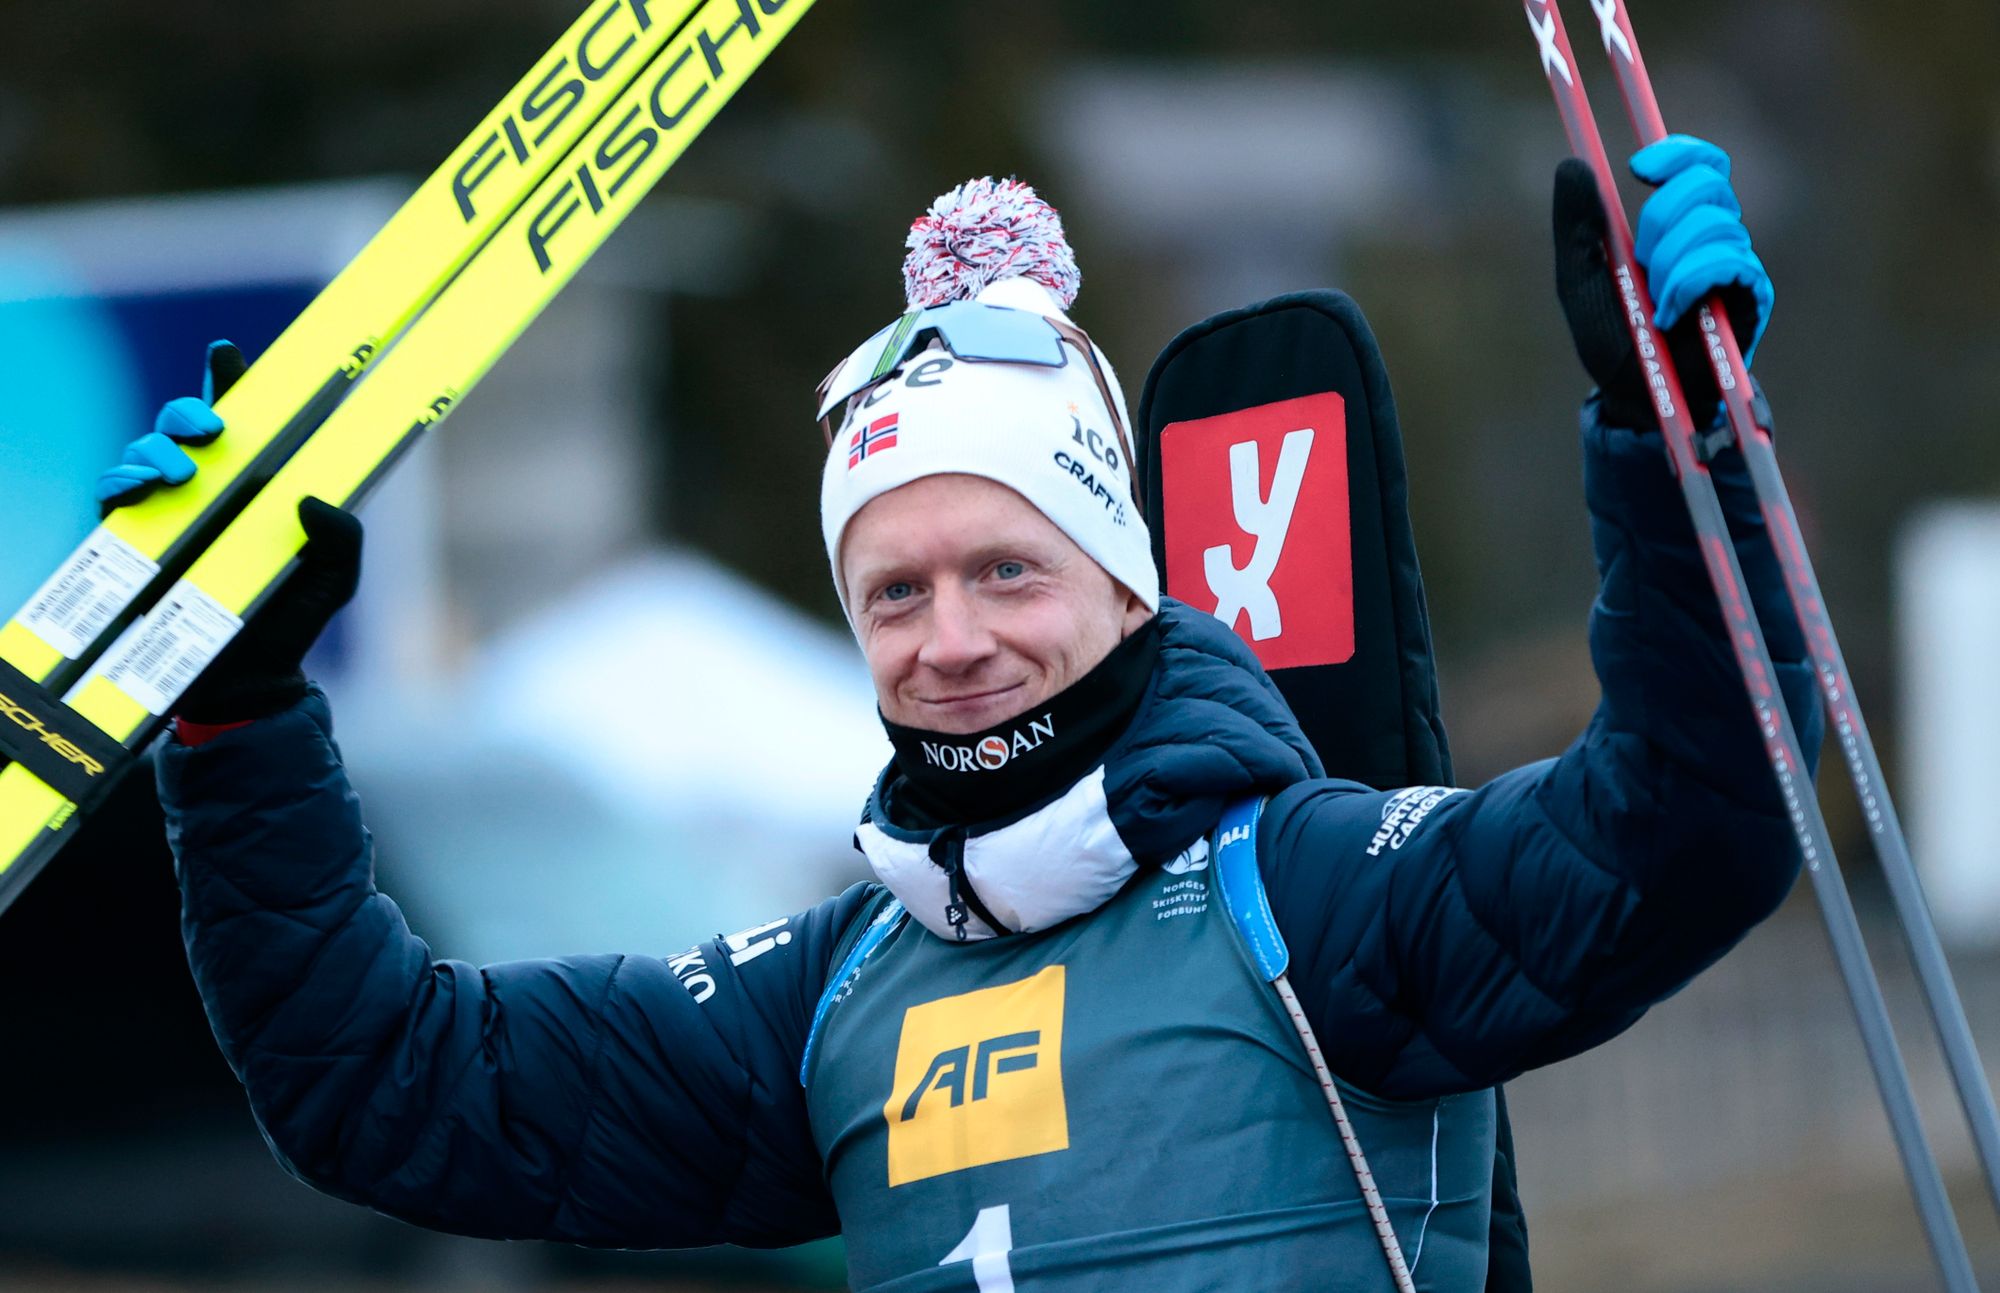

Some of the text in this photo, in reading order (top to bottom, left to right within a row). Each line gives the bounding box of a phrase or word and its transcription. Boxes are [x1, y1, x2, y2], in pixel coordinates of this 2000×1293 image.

[1053, 451, 1116, 511] CRAFT
[920, 712, 1056, 772] NORSAN
[1366, 786, 1440, 857] HURTIG
[1162, 879, 1206, 895] NORGES
[900, 1030, 1041, 1123] AF
[937, 1203, 1016, 1293] 1
